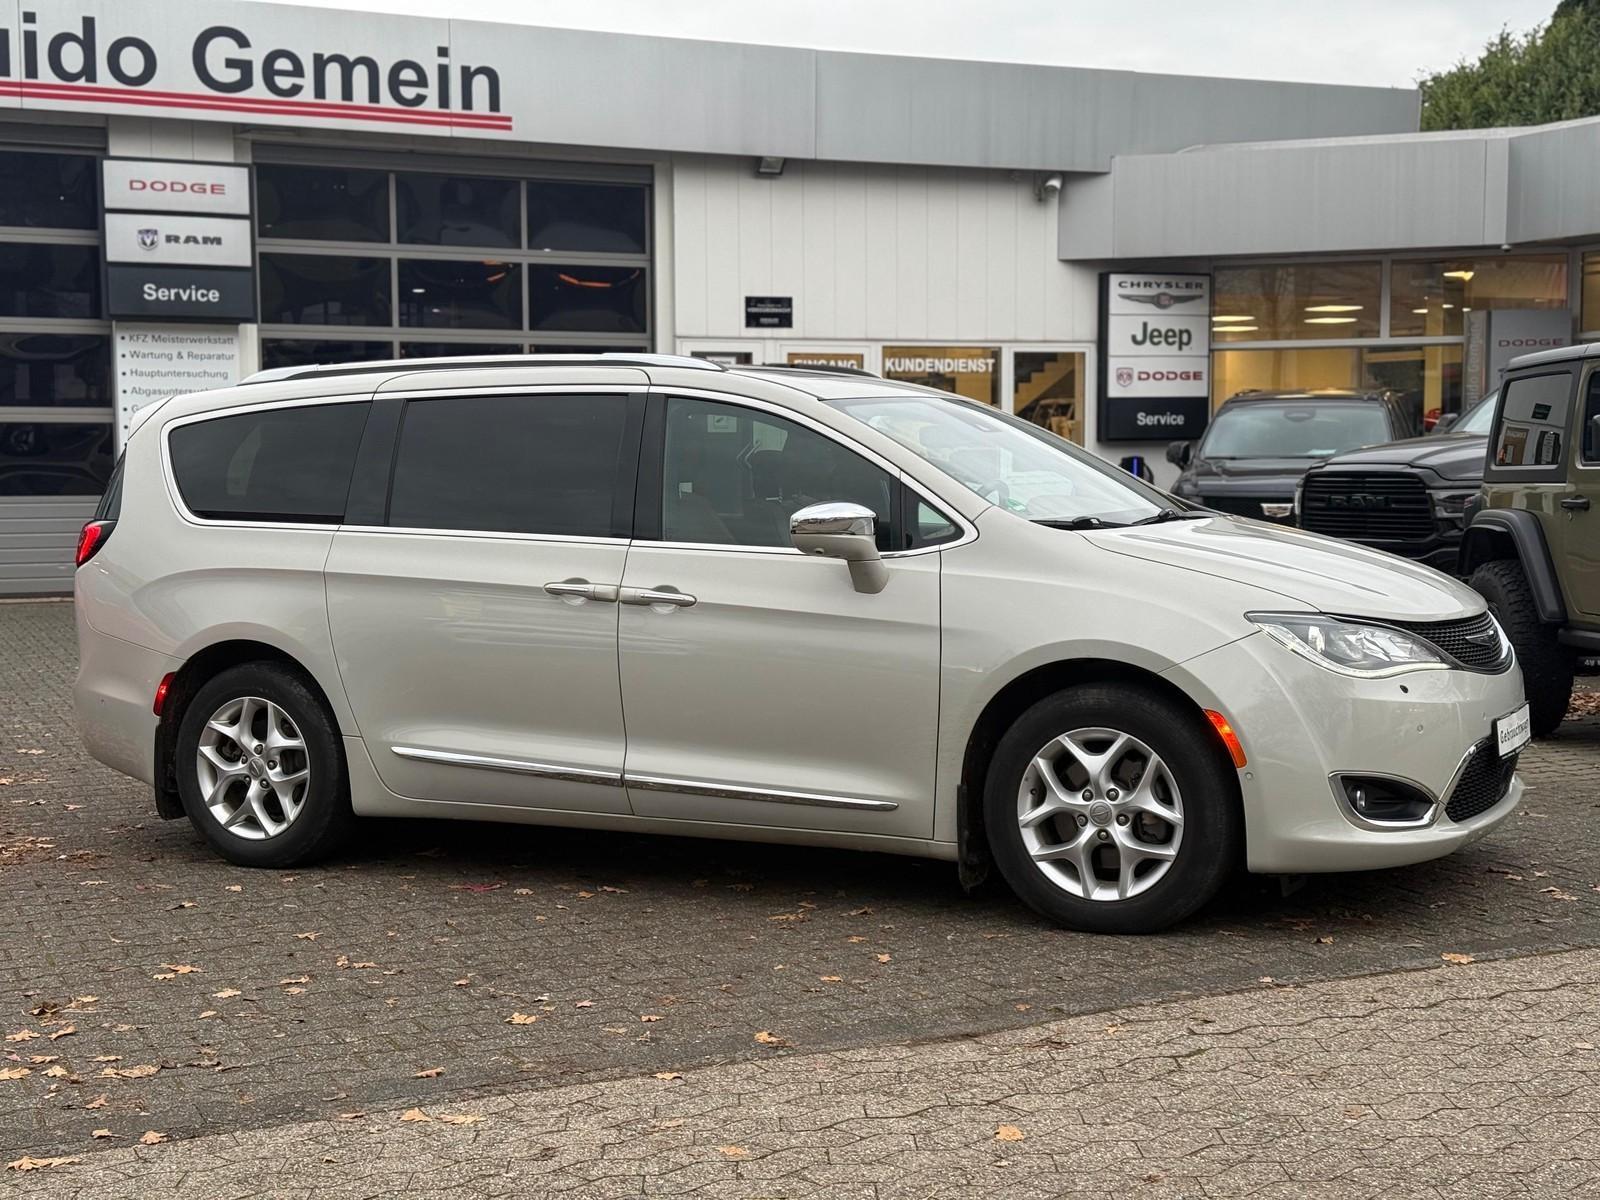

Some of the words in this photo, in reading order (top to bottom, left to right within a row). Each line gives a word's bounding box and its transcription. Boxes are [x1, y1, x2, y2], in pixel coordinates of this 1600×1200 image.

[191, 25, 501, 113] Gemein
[129, 179, 226, 195] DODGE
[165, 234, 222, 246] RAM
[1118, 280, 1204, 290] CHRYSLER
[143, 282, 220, 303] Service
[128, 335, 149, 343] KFZ
[151, 335, 234, 345] Meisterwerkstatt
[1131, 321, 1193, 351] Jeep
[1498, 338, 1564, 348] DODGE
[129, 350, 173, 361] Wartung
[176, 351, 184, 360] &
[187, 351, 235, 361] Reparatur
[885, 358, 995, 373] KUNDENDIENST
[130, 368, 229, 379] Hauptuntersuchung
[1137, 371, 1204, 381] DODGE
[1137, 412, 1185, 425] Service
